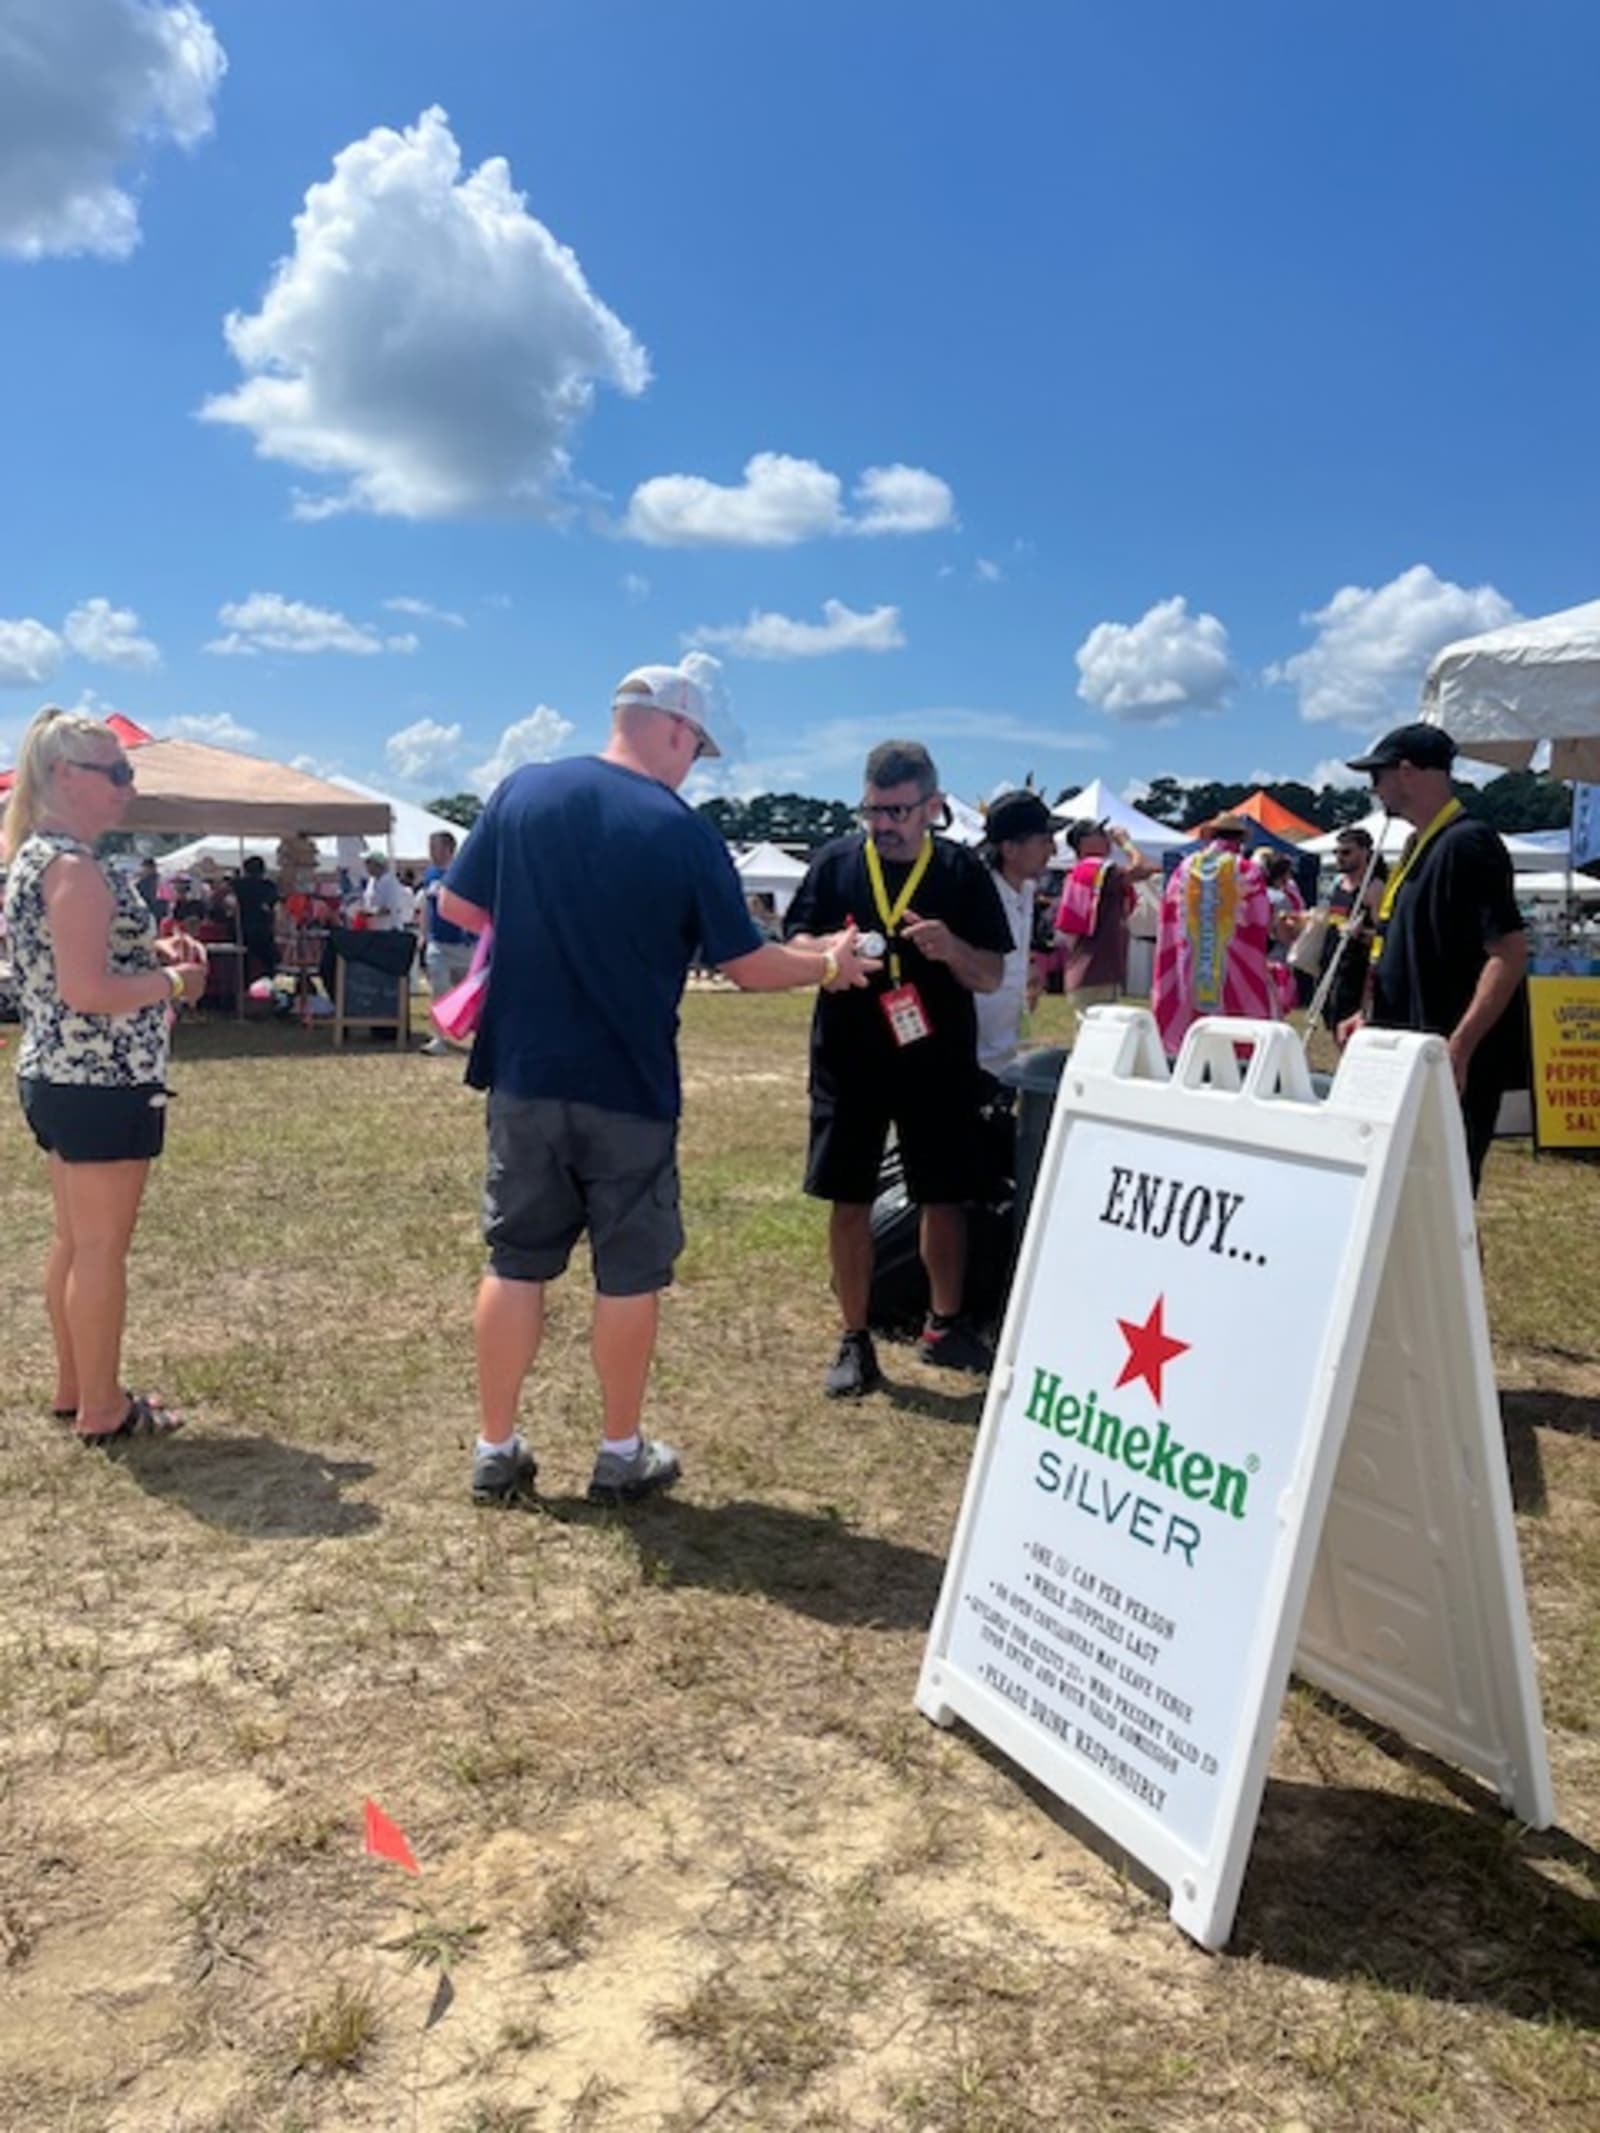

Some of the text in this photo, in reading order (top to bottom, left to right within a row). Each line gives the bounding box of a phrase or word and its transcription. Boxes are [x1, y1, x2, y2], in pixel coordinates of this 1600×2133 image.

[1565, 1112, 1600, 1131] SAL
[1099, 1166, 1267, 1267] ENJOY...
[1035, 1451, 1201, 1568] SILVER
[1031, 1539, 1053, 1566] ONE
[1072, 1564, 1097, 1593] CAN
[1098, 1579, 1124, 1609] PER
[1124, 1595, 1176, 1641] PERSON
[1032, 1571, 1160, 1666] WHILE SUPPLIES LAST
[996, 1581, 1193, 1724] NO OPEN CONTAINERS MAY LEAVE VENUE
[1006, 1640, 1035, 1671] ENTRY
[1036, 1661, 1058, 1688] AND
[1058, 1677, 1087, 1709] WITH
[1088, 1698, 1118, 1731] VALID
[1119, 1720, 1179, 1775] ADMISSION
[1030, 1634, 1066, 1671] GUESTS
[1088, 1675, 1114, 1705] WHO
[1114, 1692, 1164, 1740] PRESENT
[1165, 1727, 1201, 1766] VALID
[1201, 1752, 1219, 1779] ID
[985, 1661, 1167, 1813] PLEASE DRINK RESPONSIBLY
